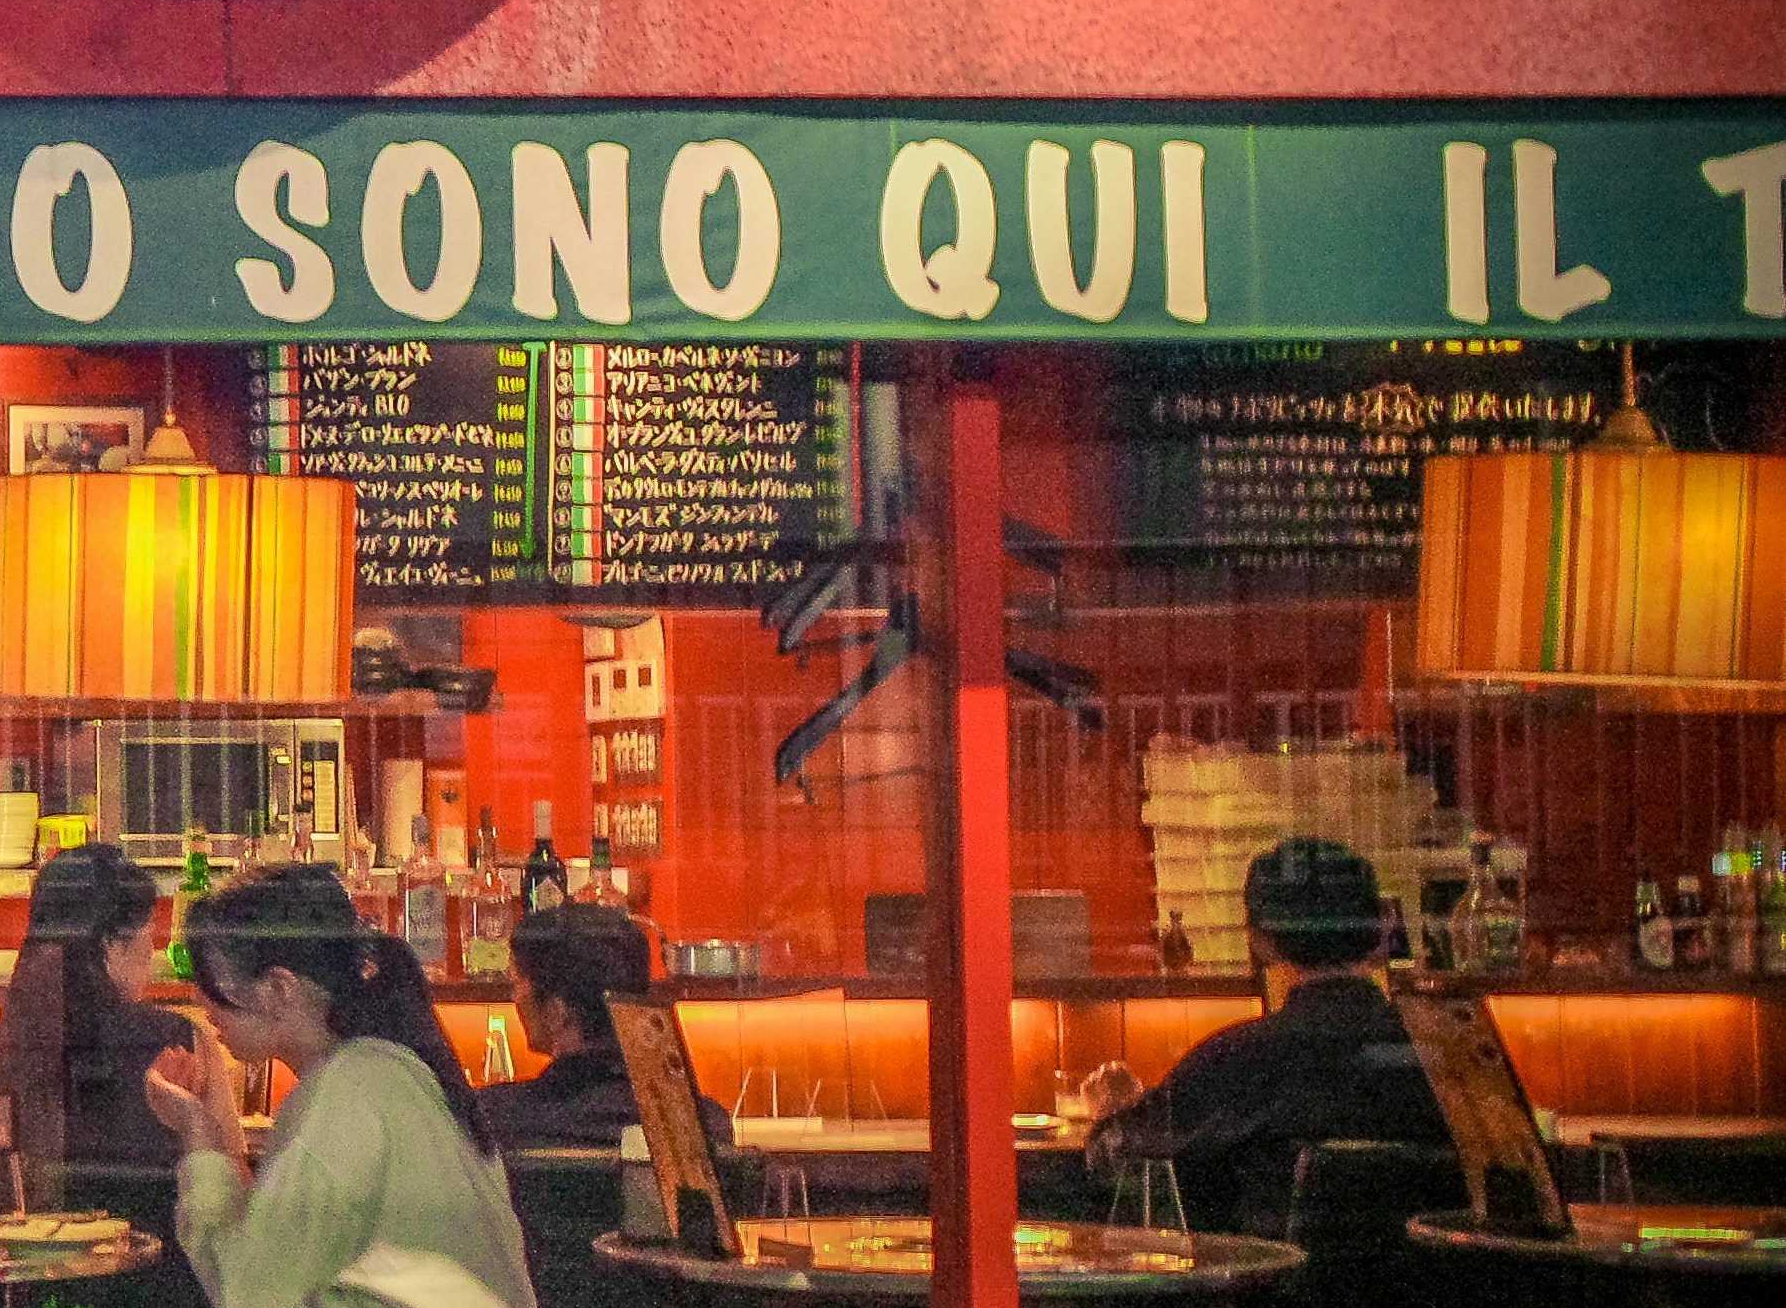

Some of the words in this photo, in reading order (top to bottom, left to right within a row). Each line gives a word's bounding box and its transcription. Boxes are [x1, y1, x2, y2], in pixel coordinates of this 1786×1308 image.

[233, 137, 783, 327] SONO
[878, 137, 1210, 325] QUI
[1443, 140, 1613, 325] IL
